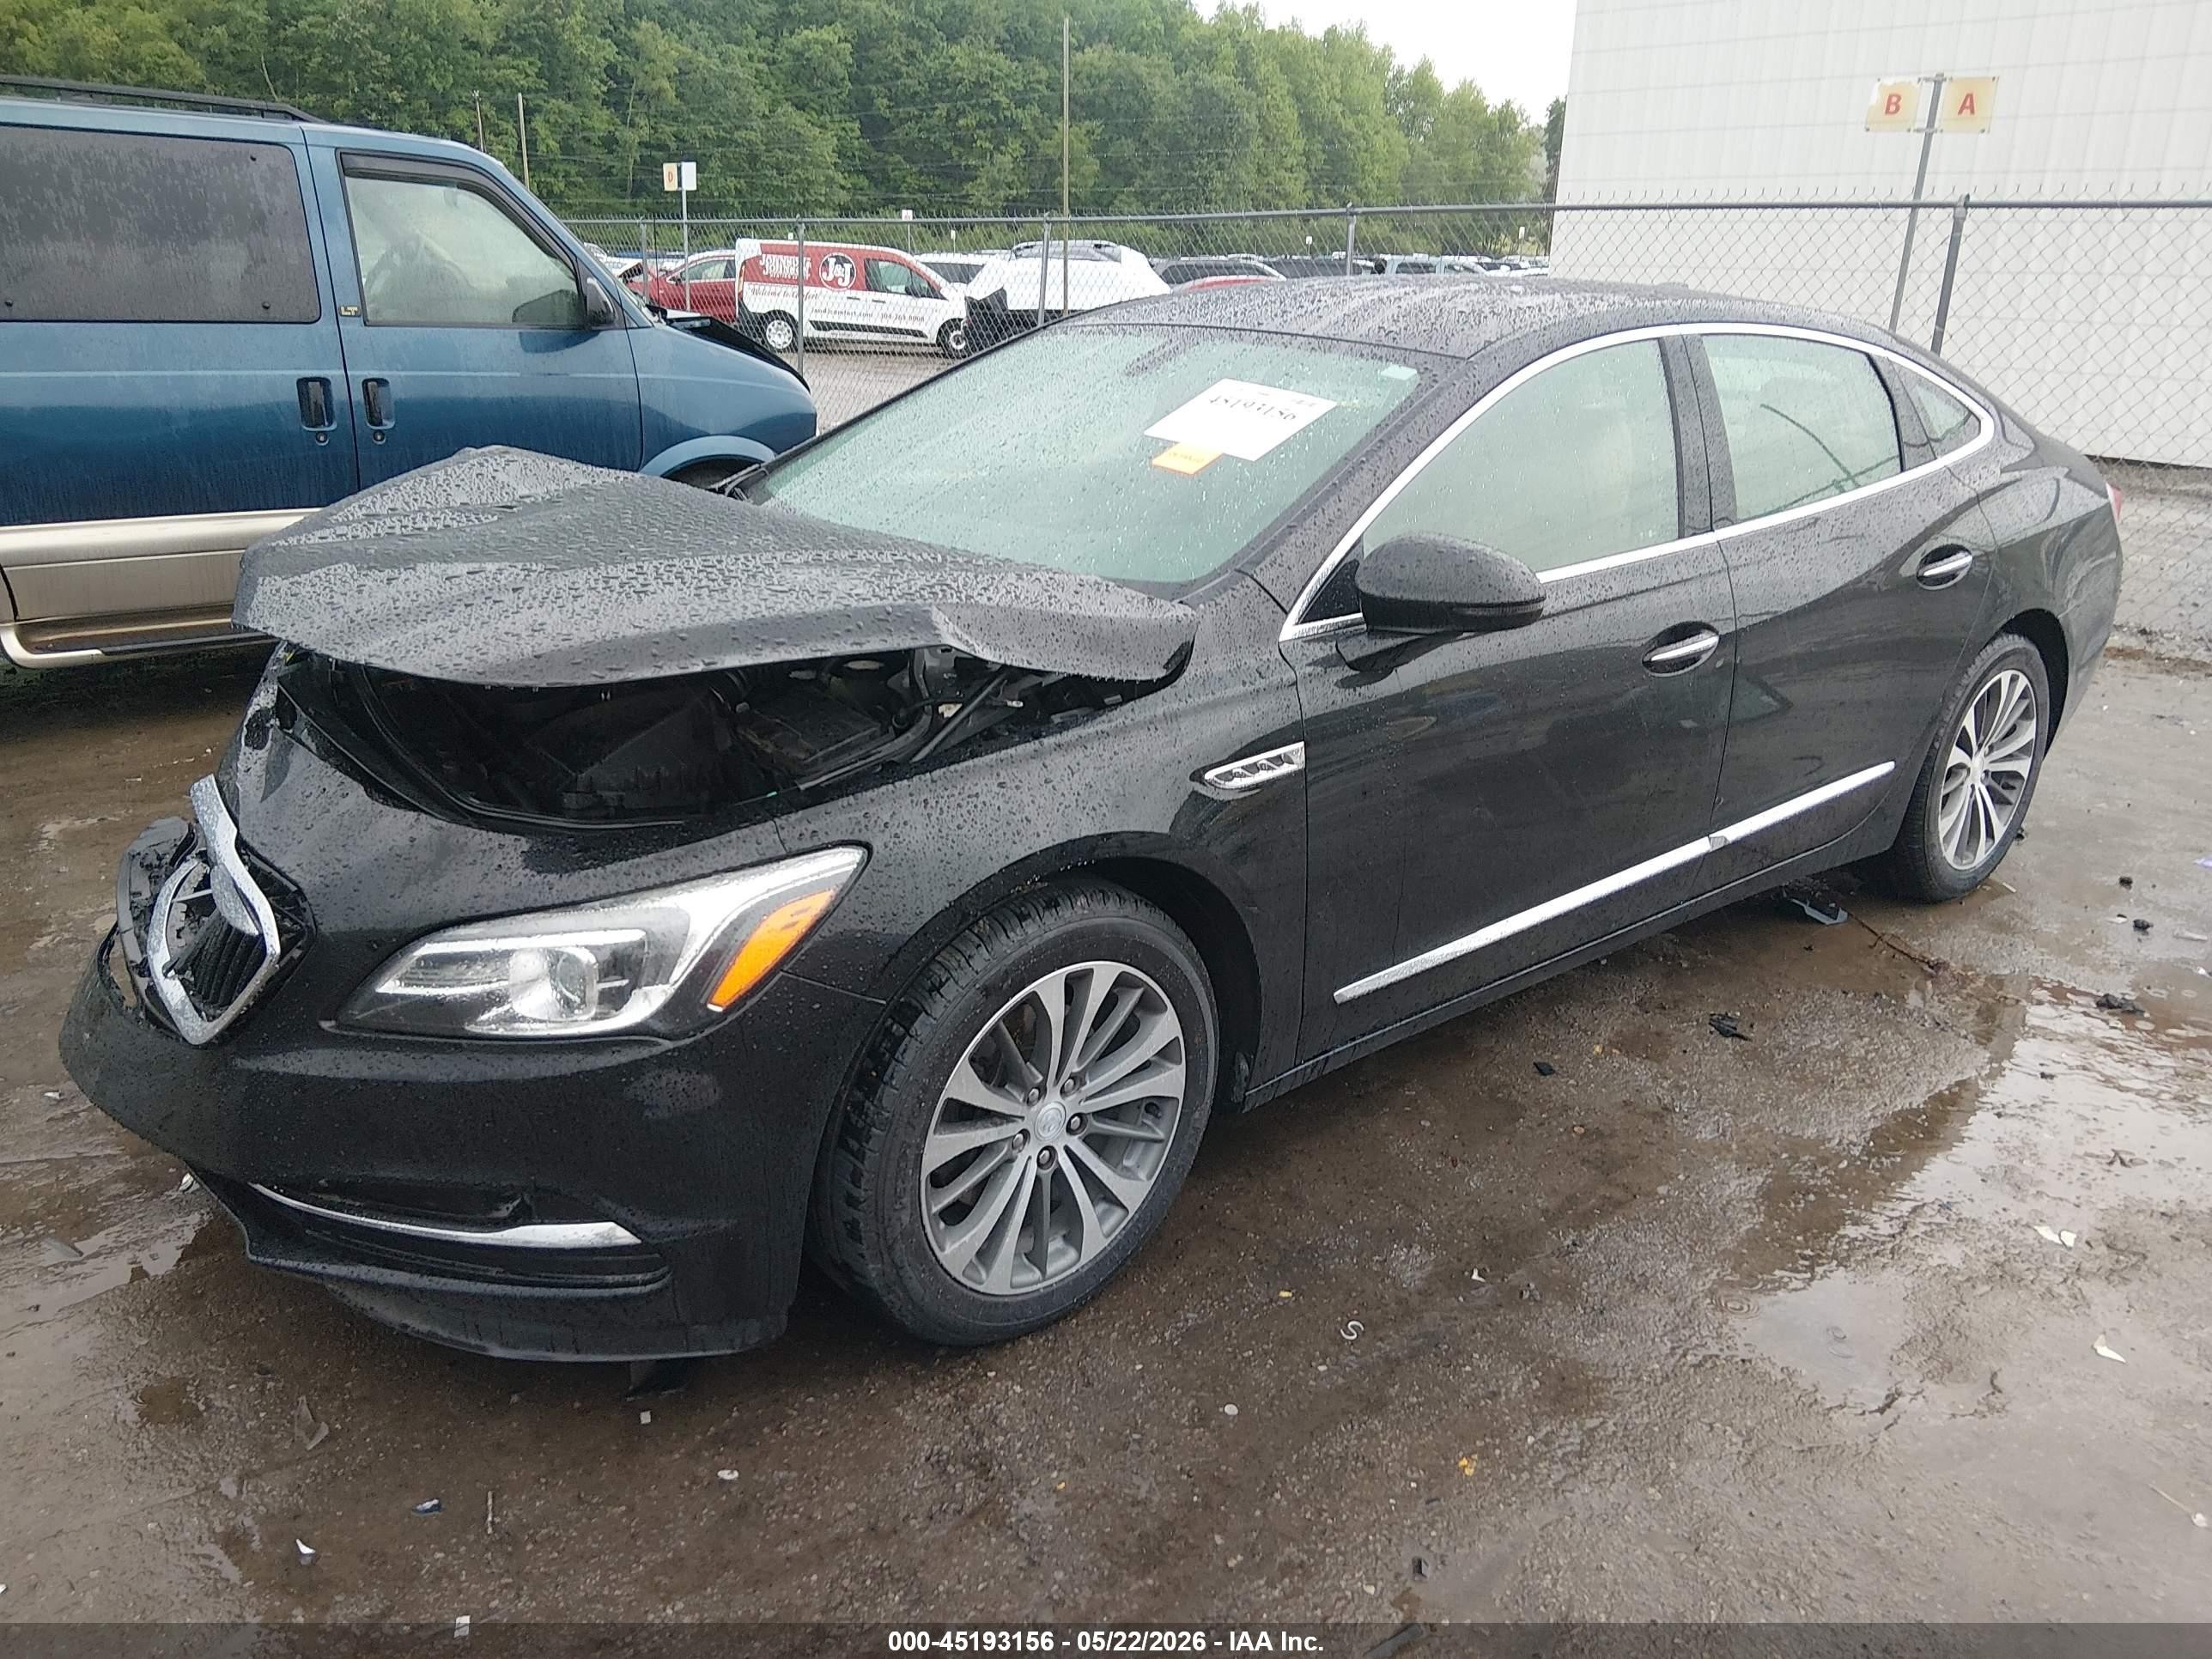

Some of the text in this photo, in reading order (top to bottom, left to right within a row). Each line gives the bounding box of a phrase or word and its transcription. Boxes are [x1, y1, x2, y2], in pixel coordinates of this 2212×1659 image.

[1884, 93, 1902, 115] B
[1957, 92, 1976, 116] A
[822, 257, 853, 287] J&J
[792, 289, 819, 301] Cofort
[340, 306, 358, 316] LT
